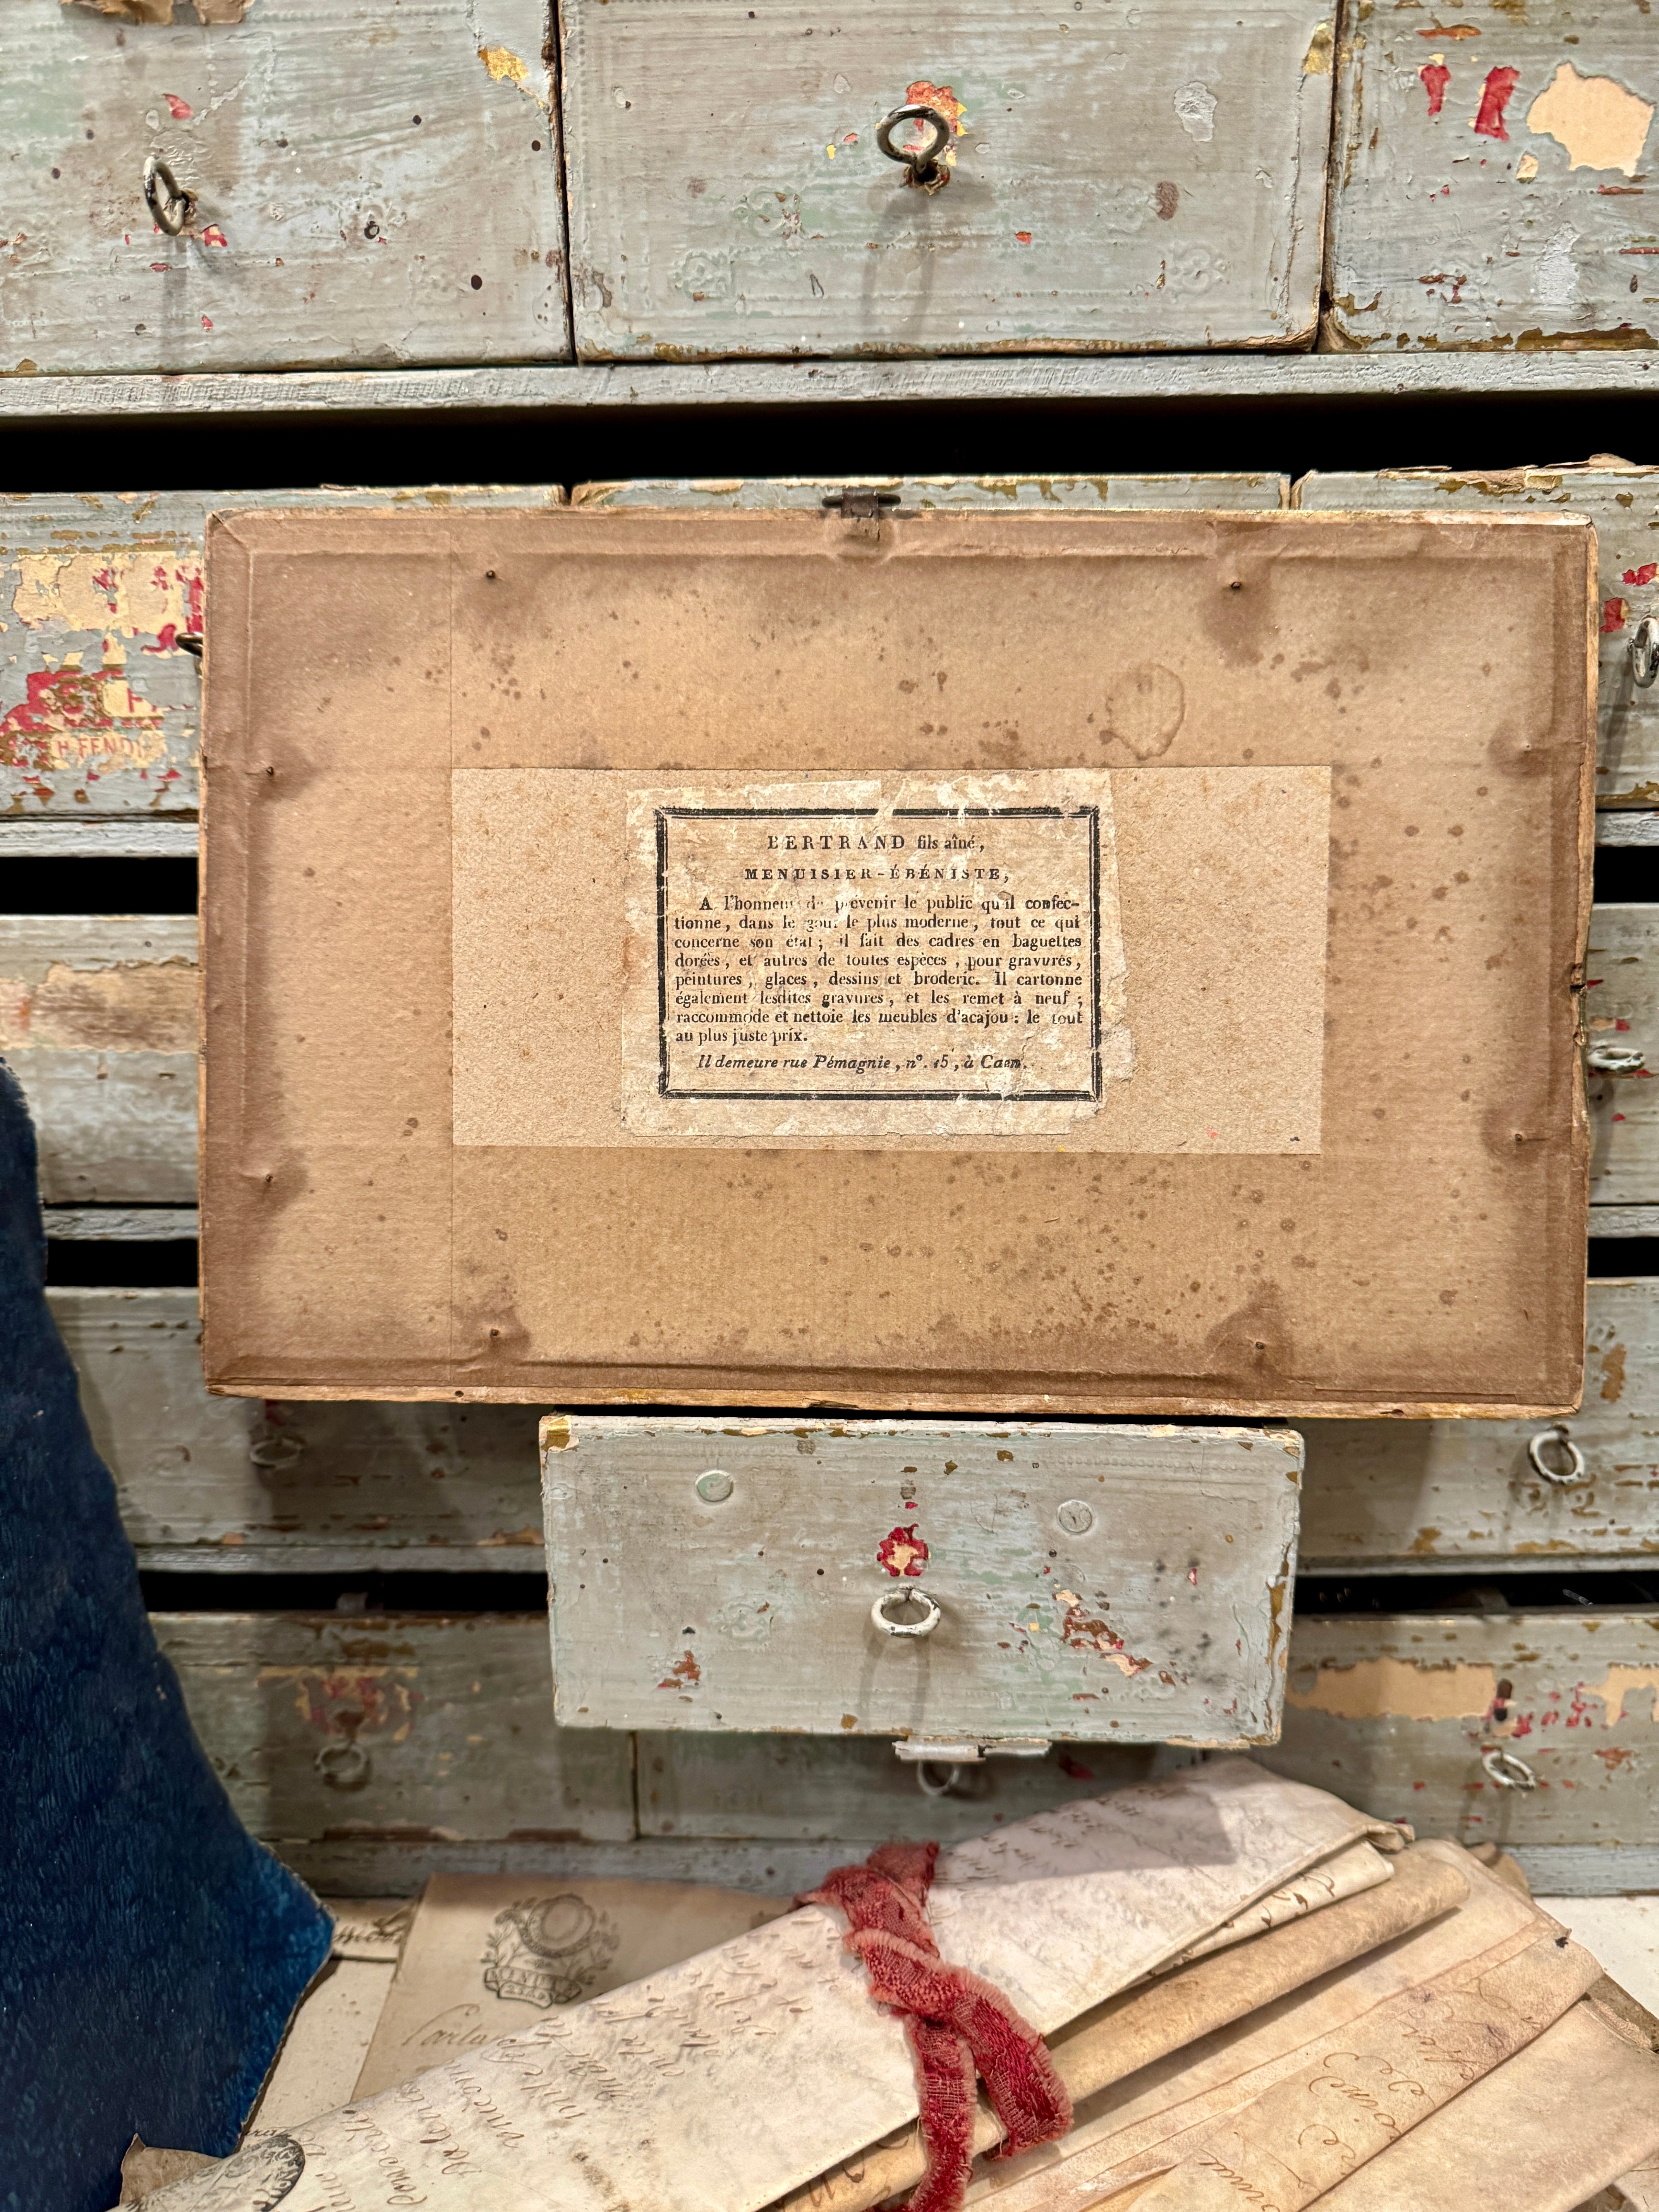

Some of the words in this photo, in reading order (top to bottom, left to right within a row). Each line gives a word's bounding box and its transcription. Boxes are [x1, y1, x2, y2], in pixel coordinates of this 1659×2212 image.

[768, 835, 904, 850] BERTRAND
[917, 835, 937, 849] fils
[944, 834, 984, 853] aîné,
[699, 897, 713, 910] A
[807, 895, 823, 910] d
[835, 895, 896, 913] pévenir
[905, 895, 917, 909] le
[927, 895, 973, 913] public
[1025, 895, 1080, 910] confec-
[675, 917, 730, 931] tionne,
[739, 915, 773, 929] dans
[783, 915, 795, 929] le
[847, 915, 858, 928] le
[867, 914, 897, 932] plus
[905, 914, 978, 931] moderne,
[990, 916, 1021, 928] tout
[1030, 919, 1045, 928] ce
[1055, 915, 1080, 932] qui
[675, 937, 740, 948] concerne
[750, 938, 773, 948] son
[839, 934, 848, 947] il
[860, 933, 883, 947] fait
[896, 933, 919, 947] des
[929, 933, 974, 947] cadres
[982, 938, 1000, 947] en
[1012, 933, 1082, 951] baguettes
[739, 955, 752, 966] et
[764, 955, 807, 966] autres
[818, 952, 835, 966] de
[847, 955, 889, 966] toutes
[968, 956, 1001, 970] pour
[765, 972, 818, 989] glaces,
[829, 971, 878, 985] dessins
[888, 974, 901, 984] et
[914, 971, 979, 985] broderie.
[995, 972, 1006, 985] Il
[1017, 974, 1082, 985] cartonne
[676, 991, 747, 1008] également
[761, 990, 811, 1004] lesdites
[822, 993, 894, 1008] gravures,
[906, 993, 919, 1004] et
[931, 990, 949, 1004] les
[963, 993, 1004, 1004] remet
[1013, 991, 1022, 1004] à
[677, 1009, 769, 1023] raccommode
[775, 1011, 787, 1023] et
[794, 1010, 843, 1023] nettoie
[852, 1010, 871, 1023] les
[878, 1009, 937, 1023] meubles
[1027, 1010, 1040, 1023] le
[1052, 1012, 1083, 1024] tout
[699, 1028, 728, 1046] plus
[733, 1028, 767, 1046] juste
[773, 1028, 808, 1046] prix.
[697, 1054, 711, 1068] Il
[715, 1055, 778, 1068] demeure
[783, 1058, 808, 1068] rue
[963, 1055, 974, 1069] à
